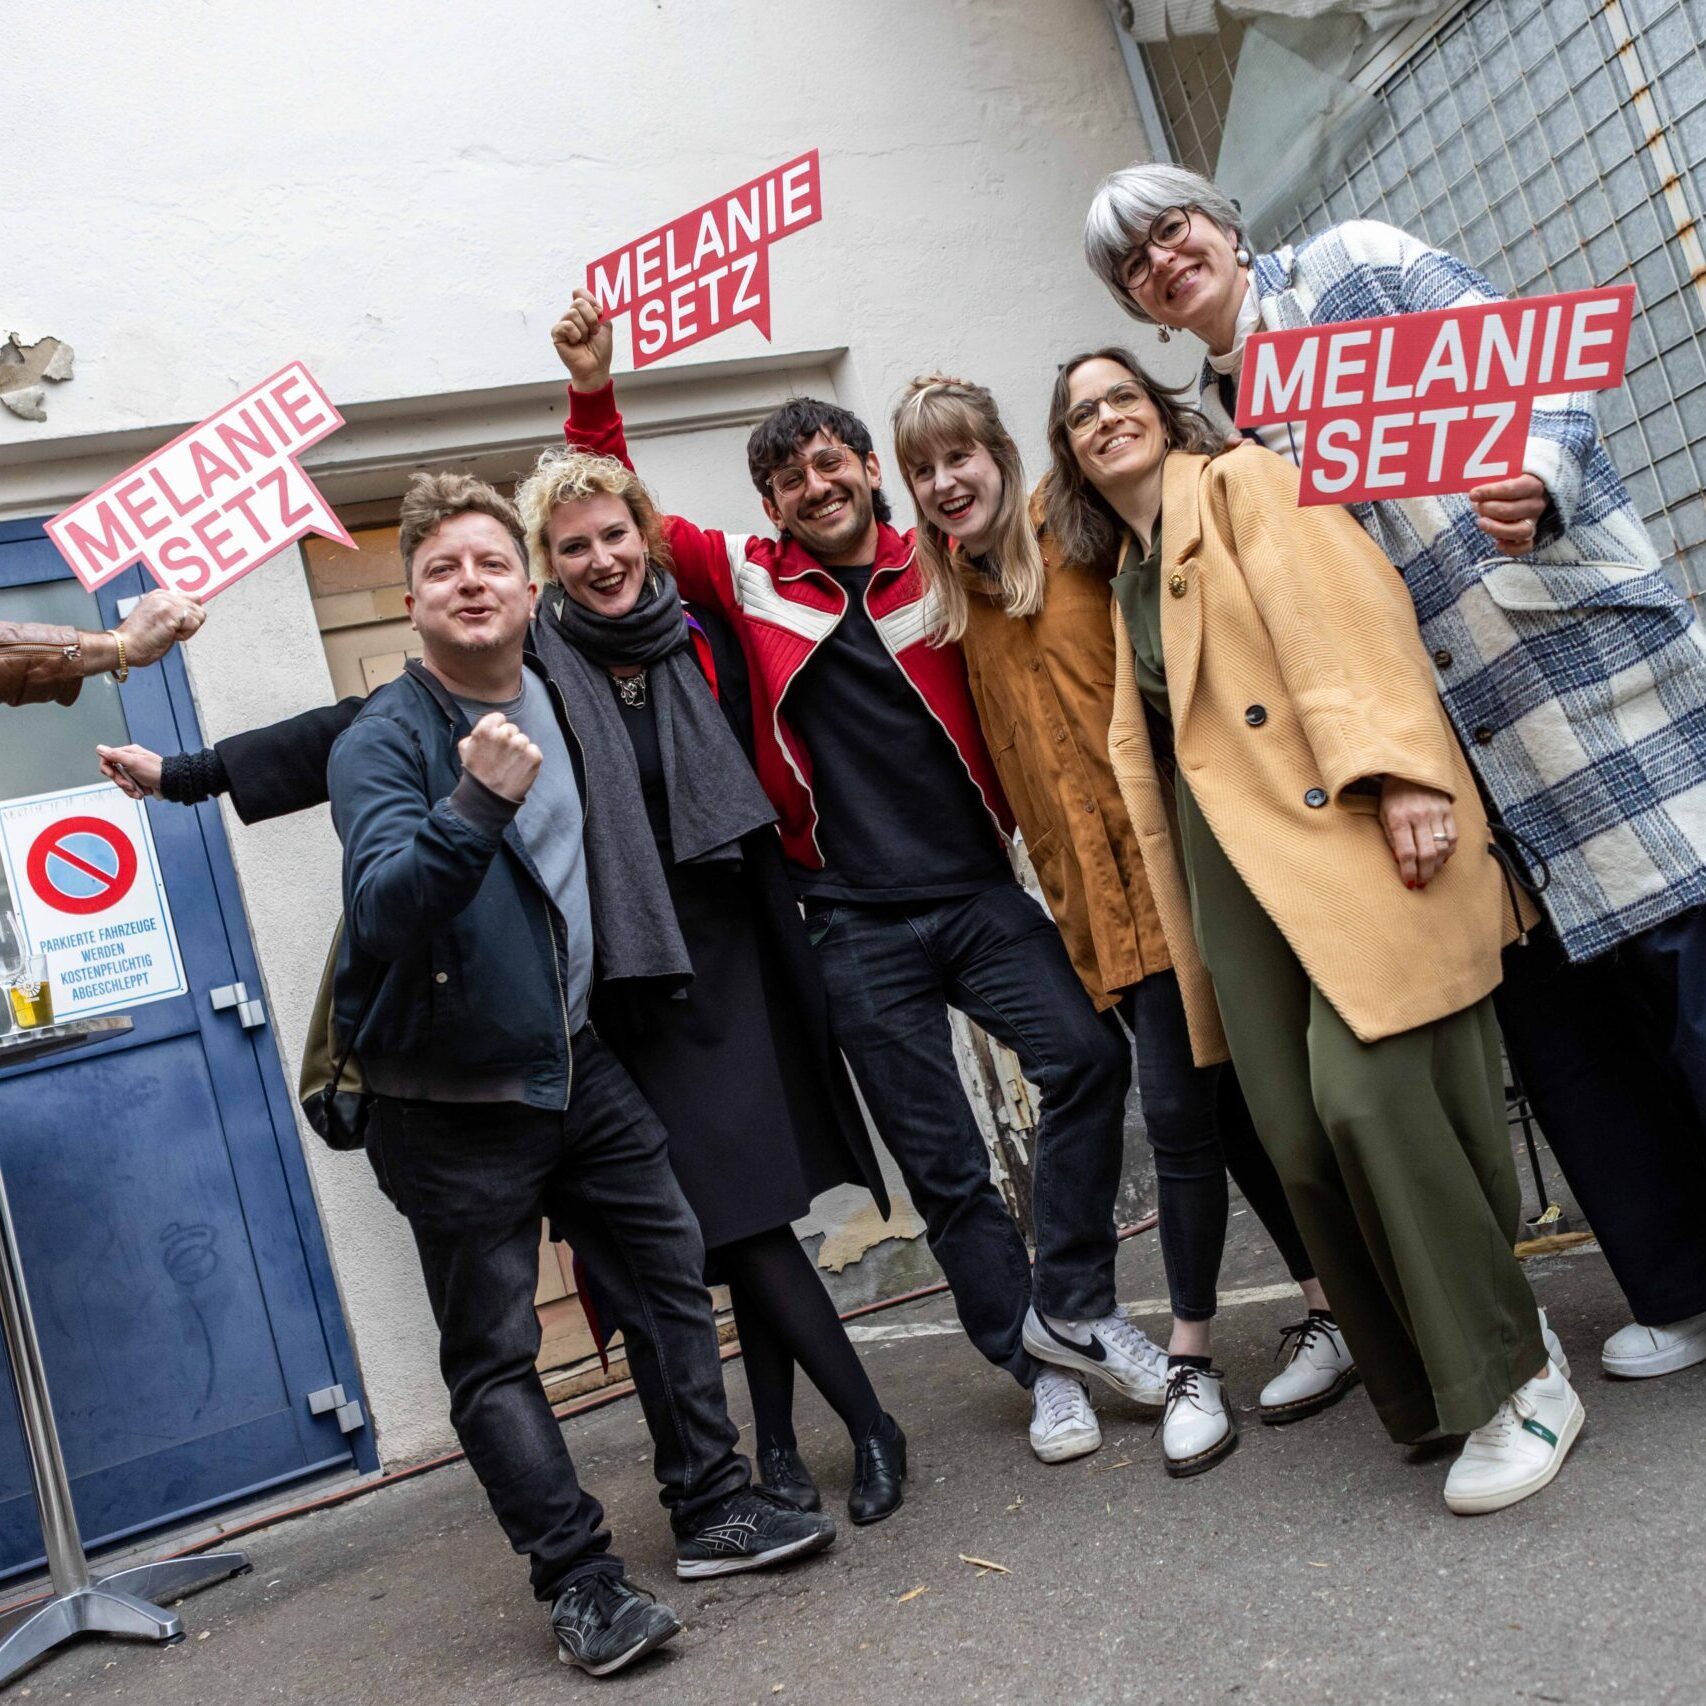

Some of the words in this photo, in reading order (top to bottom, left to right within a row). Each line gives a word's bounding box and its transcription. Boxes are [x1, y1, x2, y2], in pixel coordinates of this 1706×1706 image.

[594, 160, 812, 312] MELANIE
[638, 251, 760, 354] SETZ
[1250, 298, 1620, 416] MELANIE
[64, 375, 326, 574] MELANIE
[1311, 401, 1516, 493] SETZ
[158, 466, 313, 592] SETZ
[40, 930, 97, 954] PARKIERTE
[98, 917, 157, 940] FAHRZEUGE
[60, 953, 153, 985] KOSTENPFLICHTIG
[81, 942, 125, 963] WERDEN
[72, 972, 149, 1001] ABGESCHLEPPT
